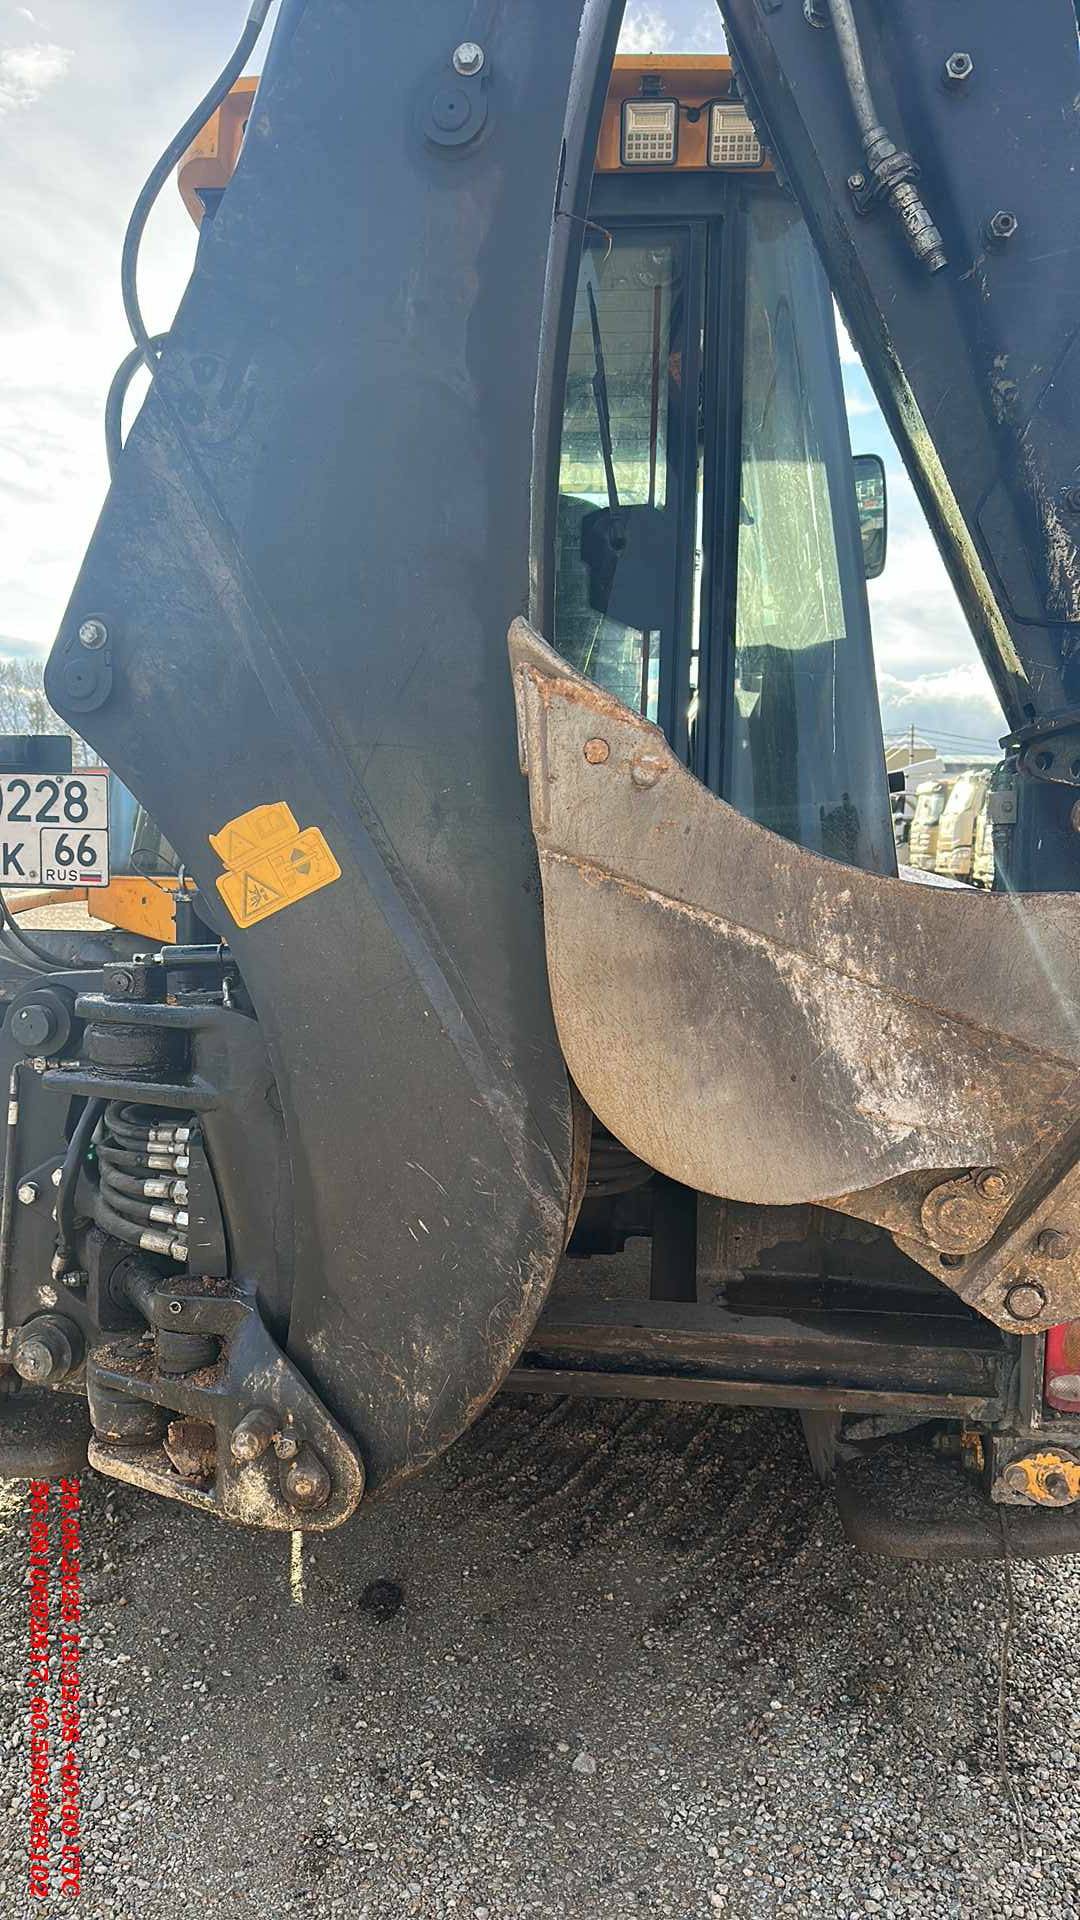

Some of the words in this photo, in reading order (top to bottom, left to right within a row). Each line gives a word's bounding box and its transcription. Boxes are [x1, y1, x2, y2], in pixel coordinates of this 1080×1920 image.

[0, 779, 89, 823] 228
[2, 842, 26, 876] K
[55, 833, 97, 867] 66
[46, 869, 78, 881] RUS
